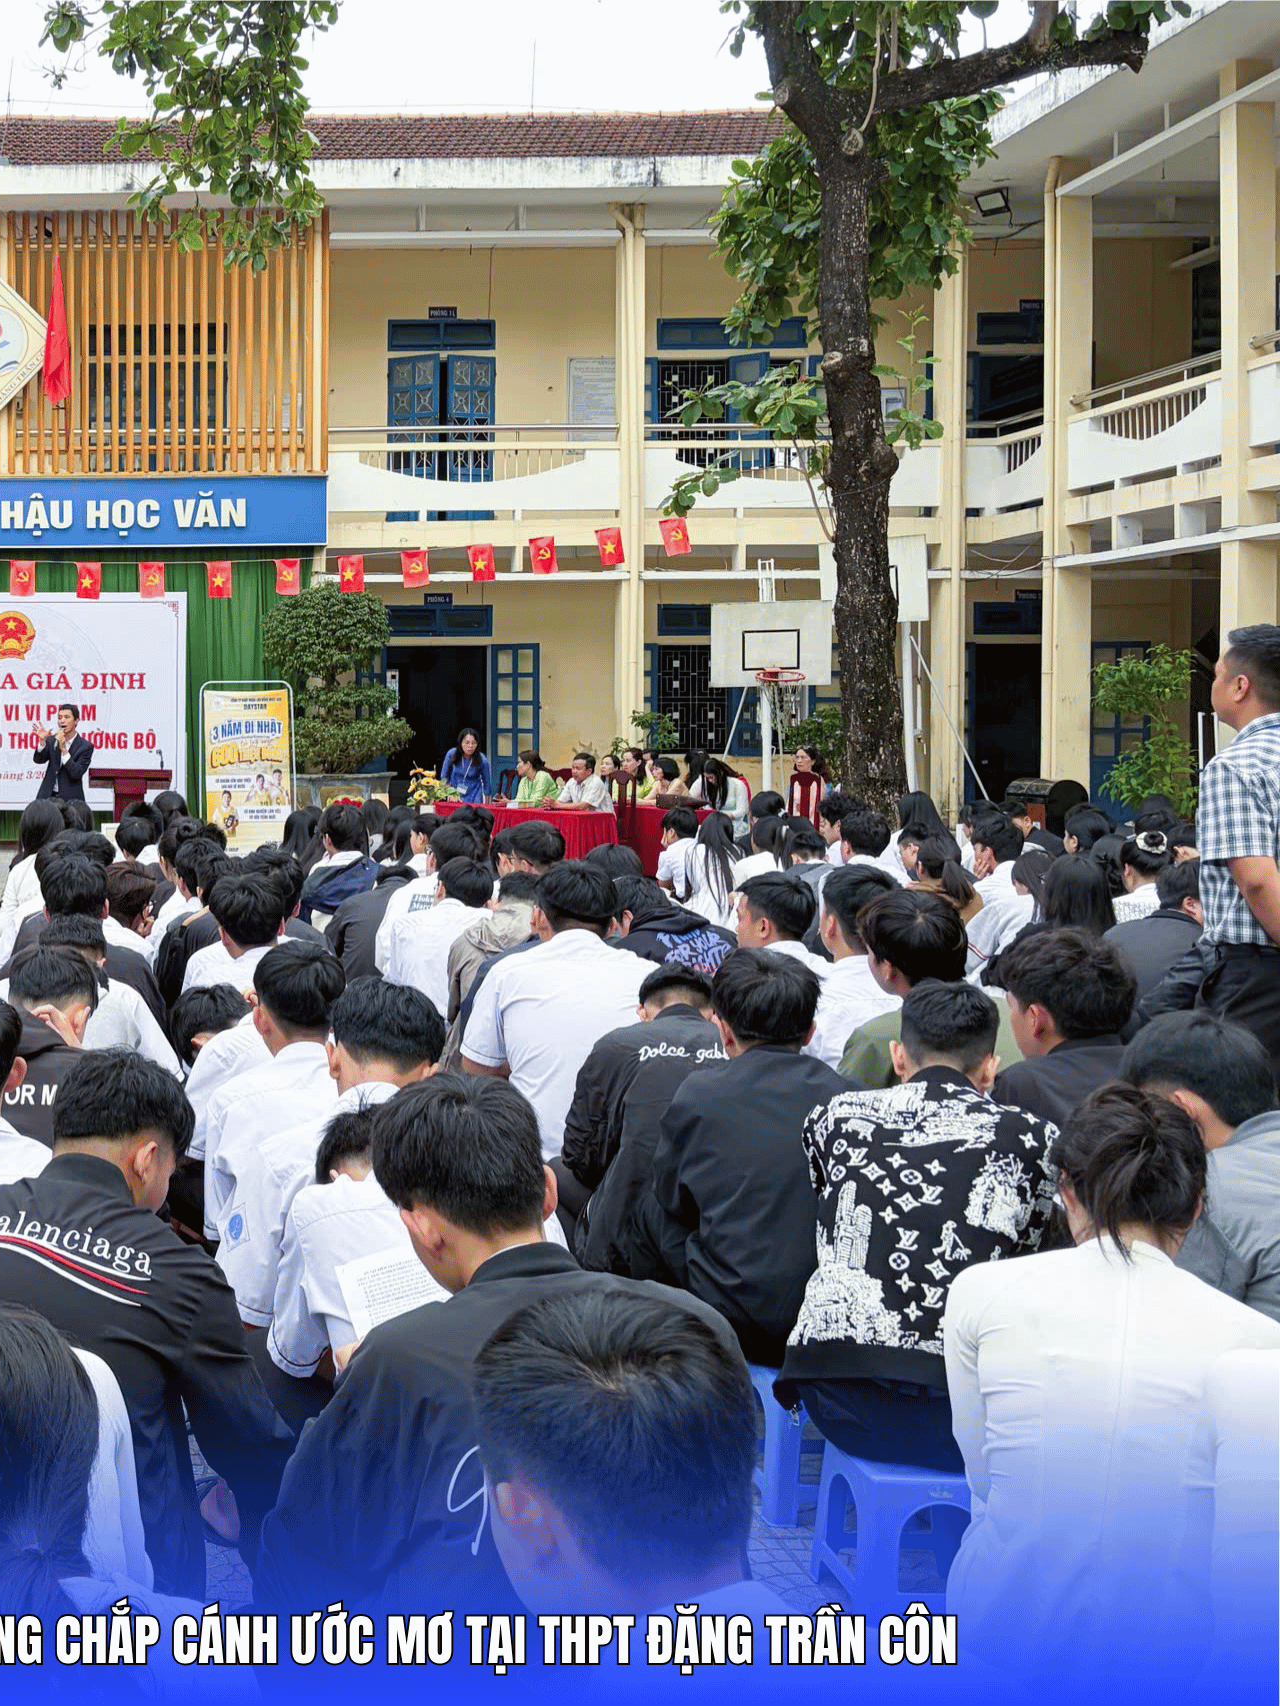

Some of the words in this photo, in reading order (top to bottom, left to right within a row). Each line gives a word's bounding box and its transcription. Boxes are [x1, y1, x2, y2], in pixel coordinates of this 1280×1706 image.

[1, 493, 72, 536] HẬU
[86, 499, 161, 537] HỌC
[173, 490, 248, 530] VĂN
[26, 665, 73, 690] GIẢ
[81, 672, 147, 695] ĐỊNH
[46, 704, 97, 721] PM
[81, 728, 128, 750] ƯỜNG
[133, 728, 157, 754] BỘ
[212, 726, 219, 741] 3
[221, 719, 242, 738] NĂM
[245, 720, 254, 734] ĐI
[257, 718, 282, 736] NHẬT
[638, 1041, 690, 1062] Dolce
